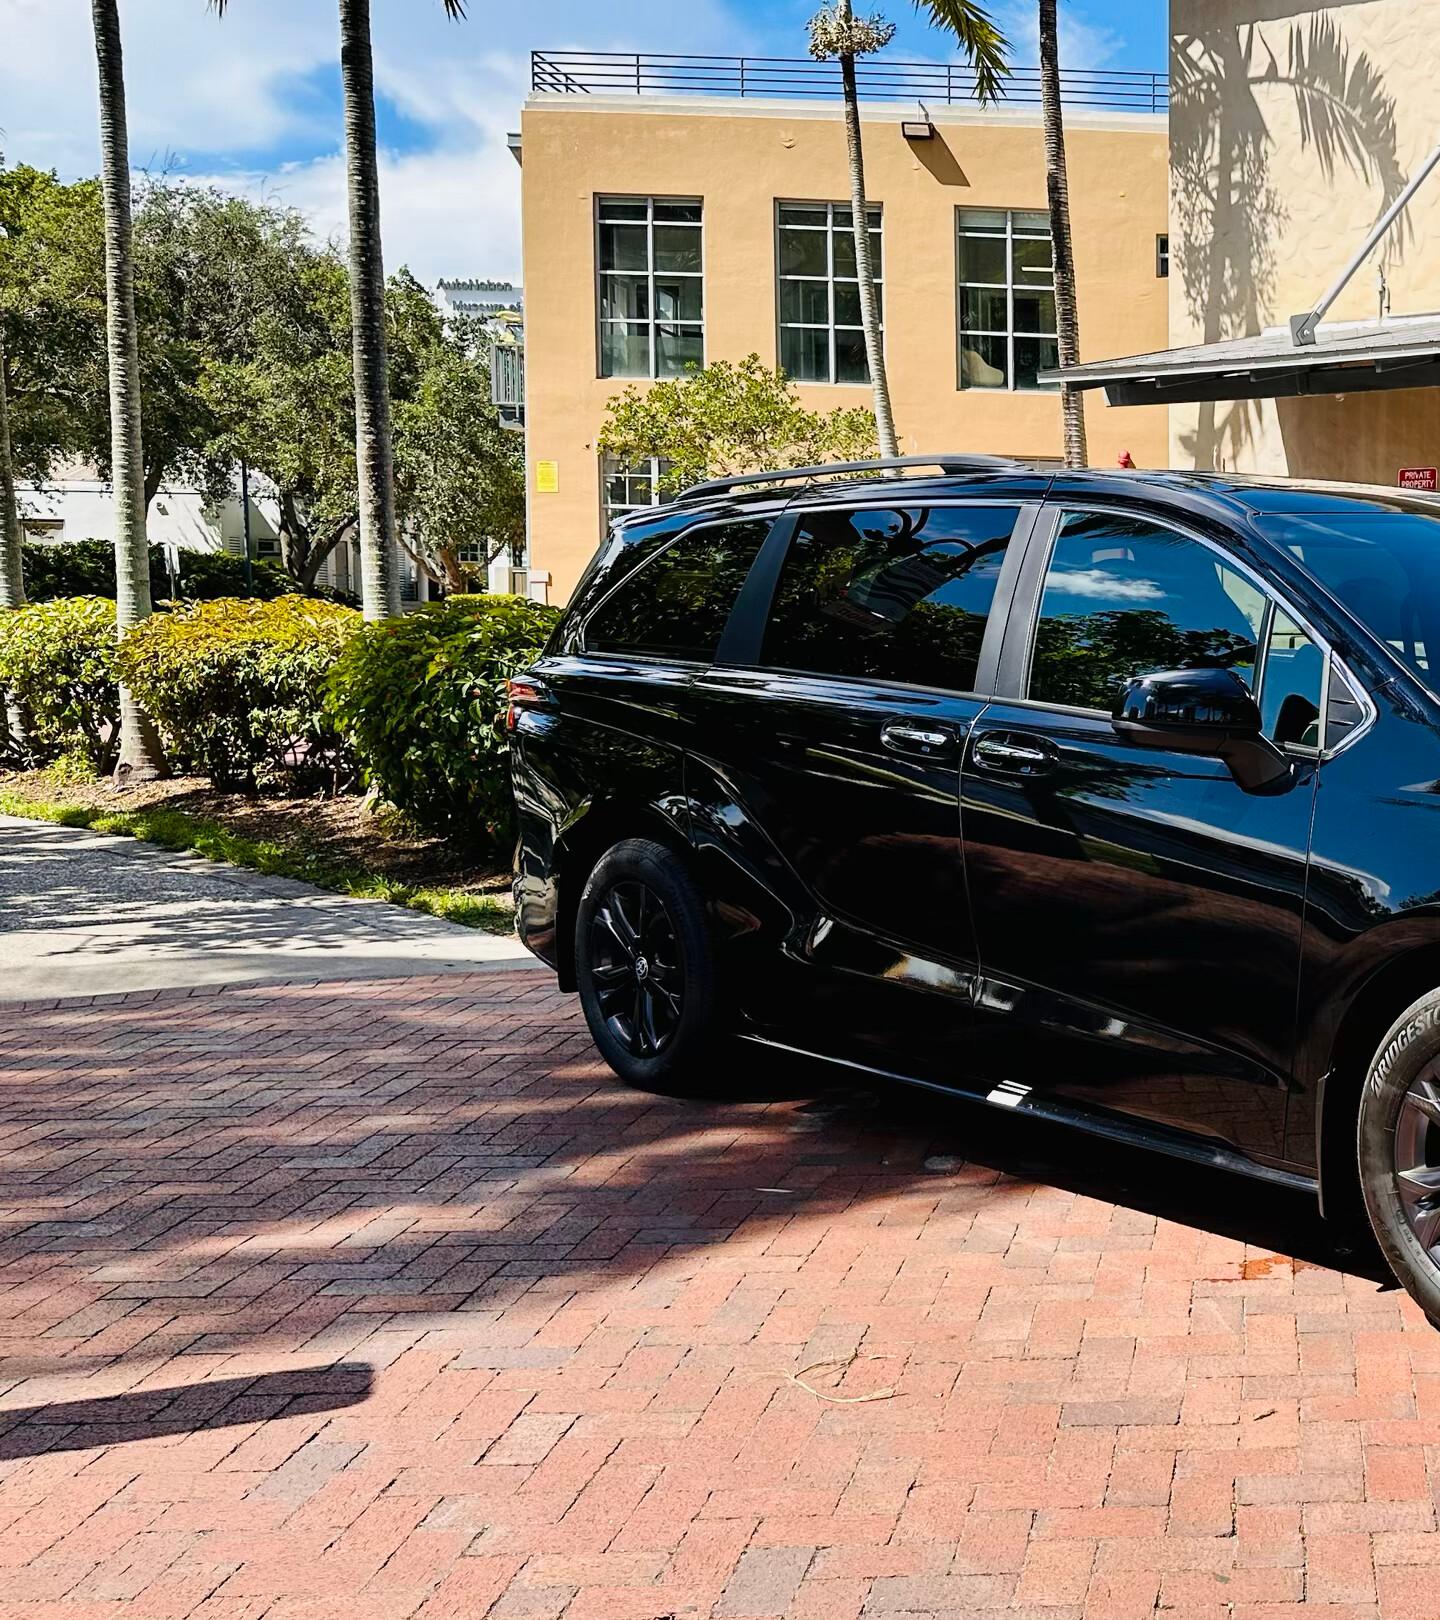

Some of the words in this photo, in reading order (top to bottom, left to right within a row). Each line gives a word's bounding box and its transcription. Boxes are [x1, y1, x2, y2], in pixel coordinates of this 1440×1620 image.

[437, 278, 512, 291] AutoNation
[453, 300, 505, 311] Museum
[1404, 471, 1431, 479] PRIVATE
[1401, 479, 1434, 488] PROPERTY
